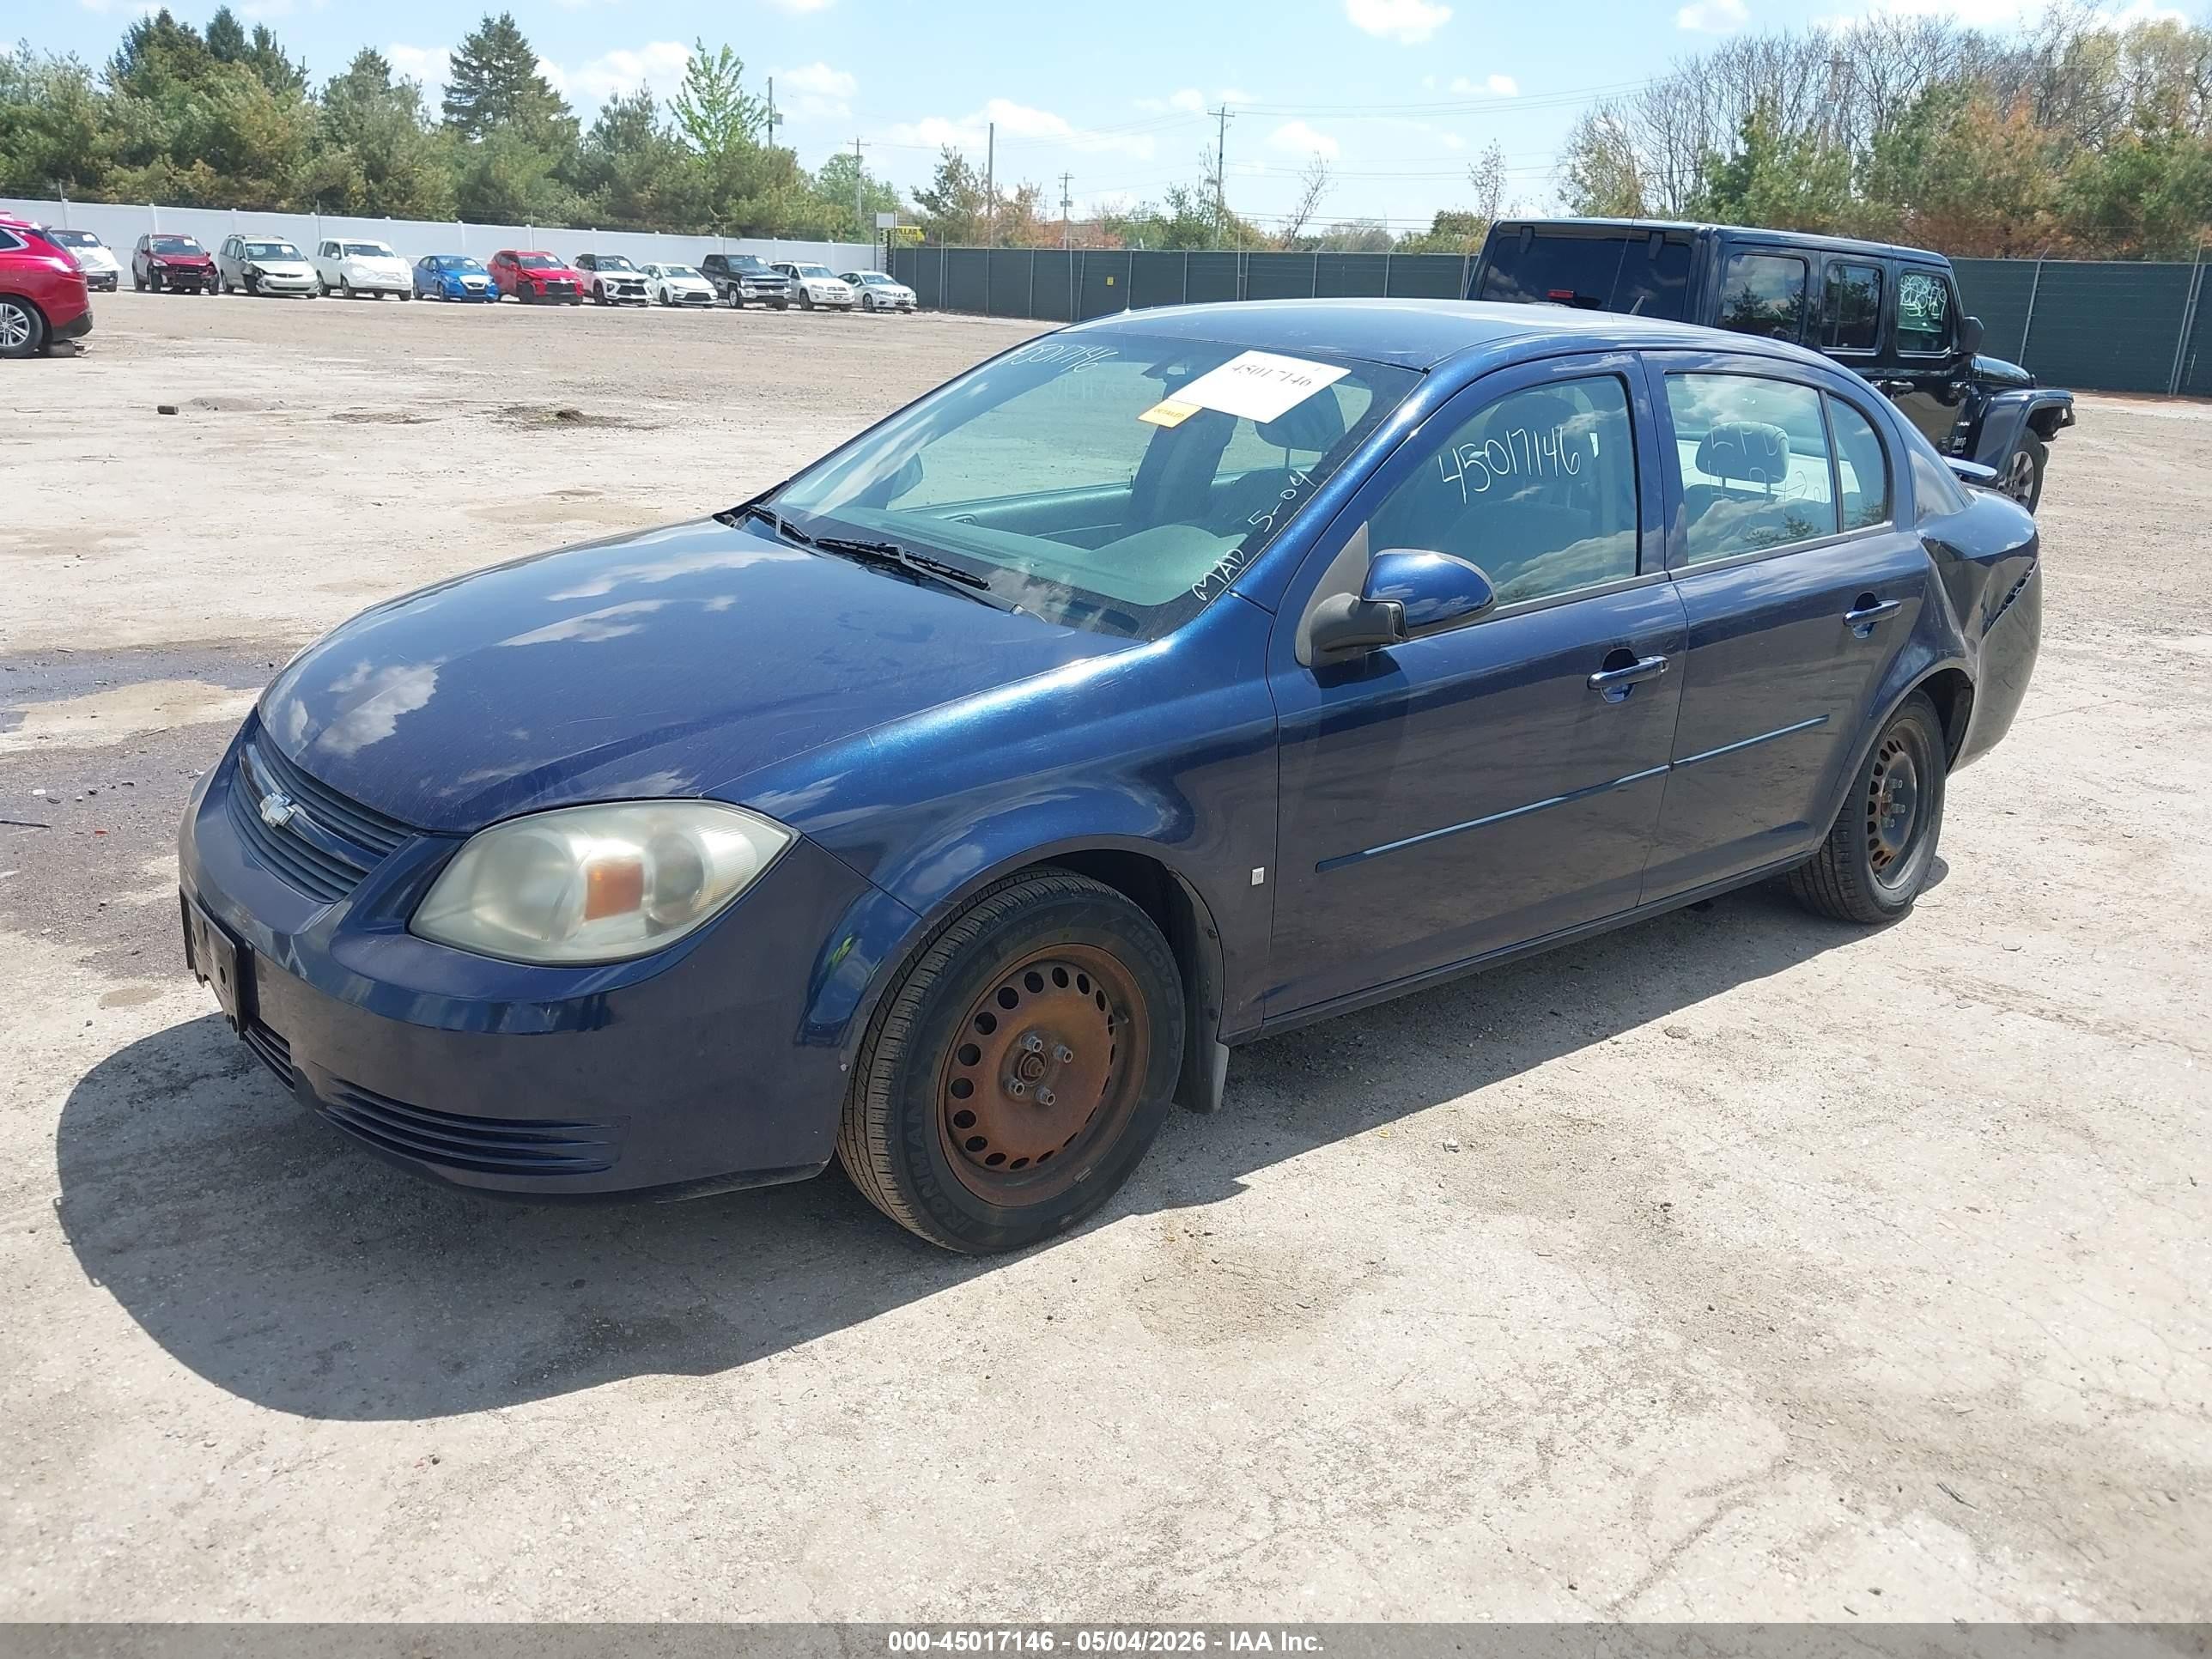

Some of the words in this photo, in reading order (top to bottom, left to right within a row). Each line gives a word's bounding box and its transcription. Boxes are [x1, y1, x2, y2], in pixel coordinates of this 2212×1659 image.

[1437, 426, 1581, 505] 45017146
[1191, 548, 1245, 602] MAD
[1247, 469, 1319, 533] 5-04
